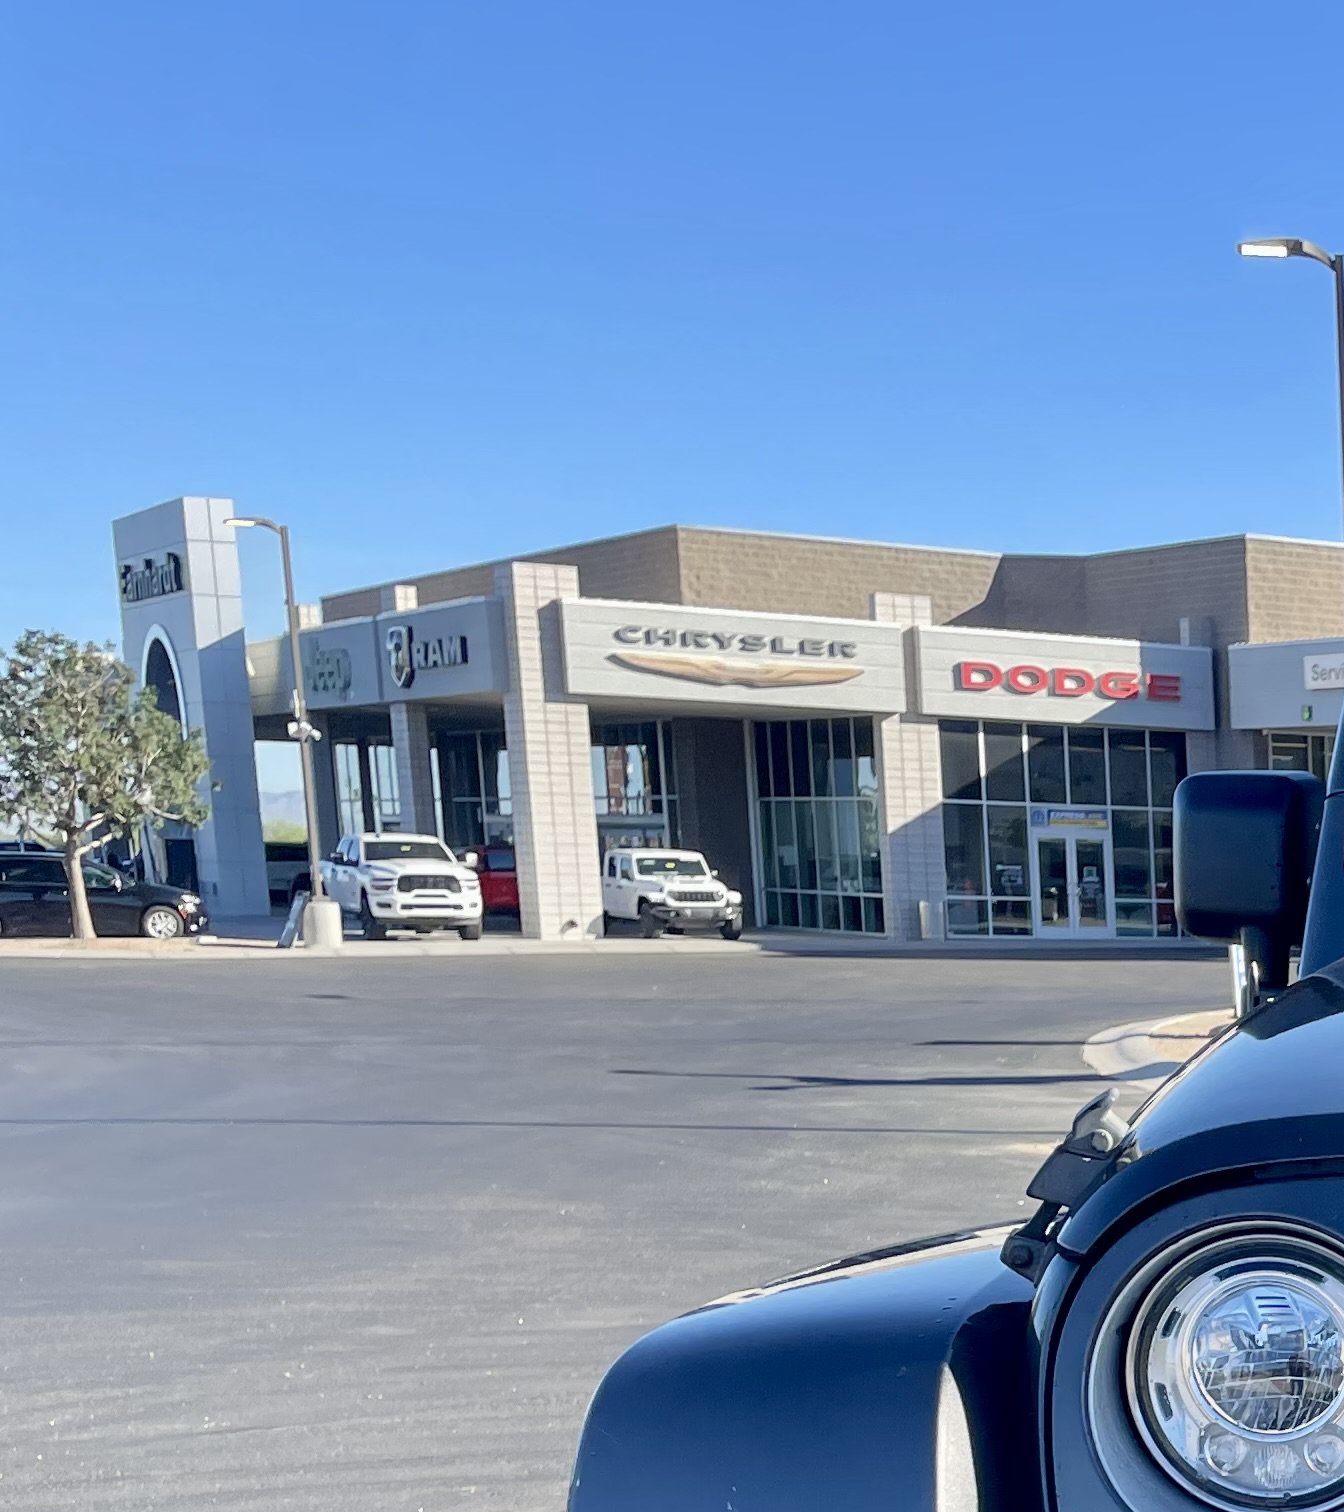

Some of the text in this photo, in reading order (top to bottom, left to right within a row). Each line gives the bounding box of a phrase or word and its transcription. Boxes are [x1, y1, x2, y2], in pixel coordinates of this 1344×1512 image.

[412, 634, 468, 671] RAM
[612, 624, 858, 661] CHRYSLER
[957, 660, 1182, 701] DODGE
